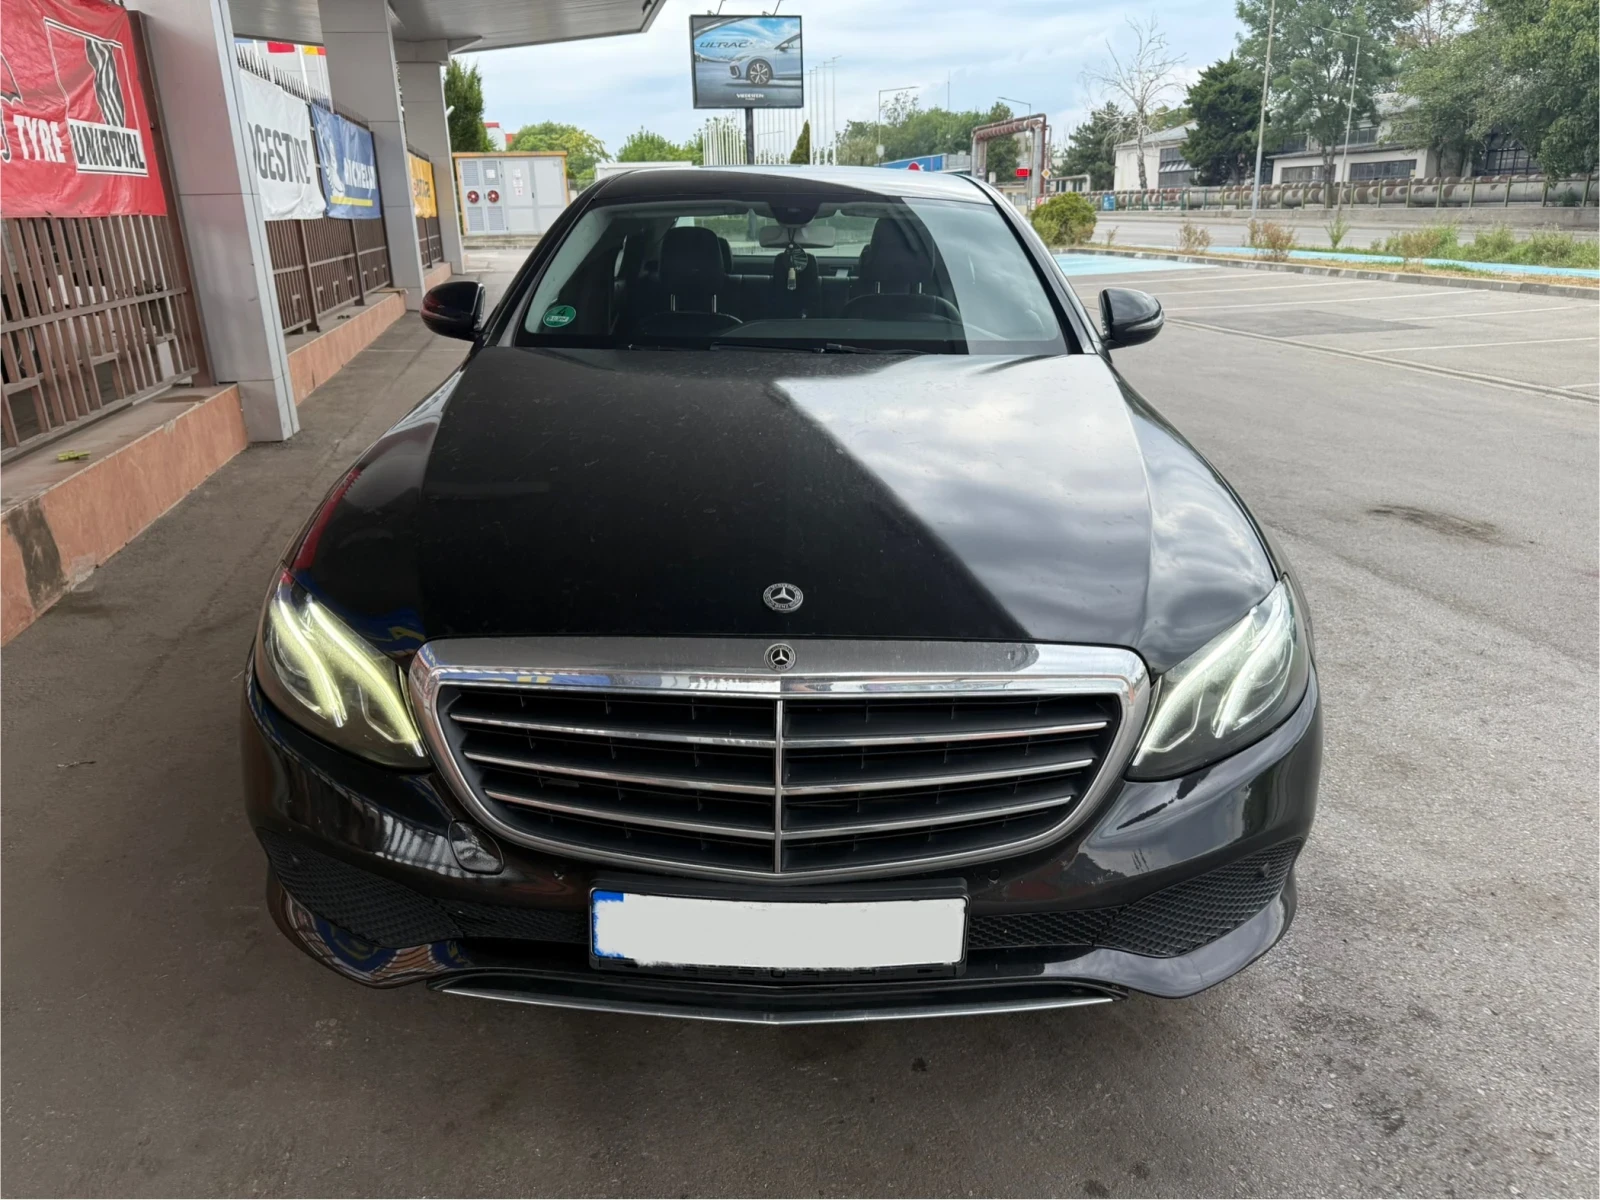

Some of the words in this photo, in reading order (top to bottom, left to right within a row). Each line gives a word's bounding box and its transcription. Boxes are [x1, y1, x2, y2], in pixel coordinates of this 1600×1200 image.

[13, 115, 66, 163] TYRE
[70, 125, 145, 169] UNIROYAL
[557, 307, 567, 316] 4
